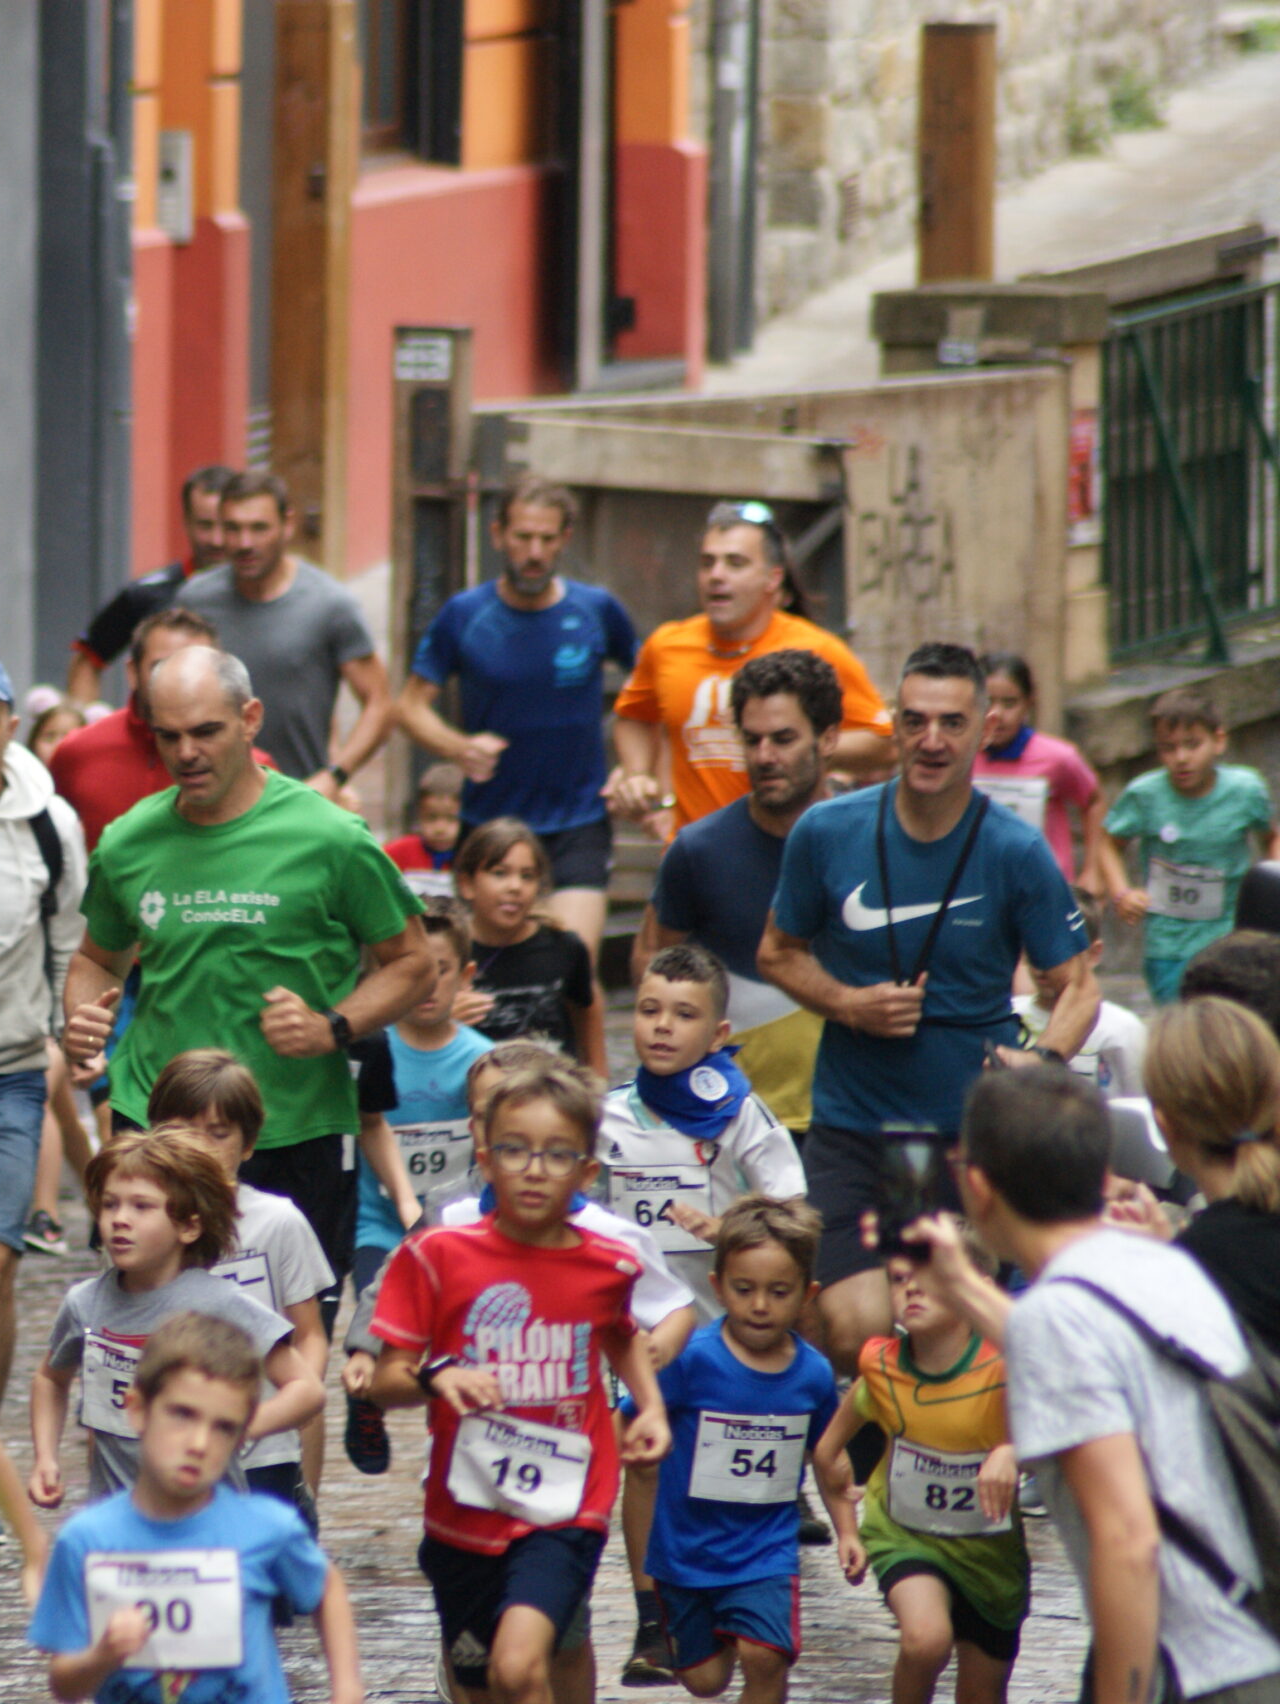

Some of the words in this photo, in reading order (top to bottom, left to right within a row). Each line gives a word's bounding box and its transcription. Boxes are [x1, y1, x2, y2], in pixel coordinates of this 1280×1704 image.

[173, 892, 191, 906] La
[195, 890, 228, 904] ELA
[229, 891, 280, 906] existe
[181, 908, 267, 924] ConócELA
[408, 1150, 447, 1175] 69
[634, 1199, 676, 1228] 64
[476, 1316, 573, 1362] PILÓN
[104, 1350, 138, 1372] Notic
[110, 1379, 130, 1410] 5
[490, 1455, 543, 1494] 19
[729, 1448, 778, 1479] 54
[924, 1483, 976, 1512] 82
